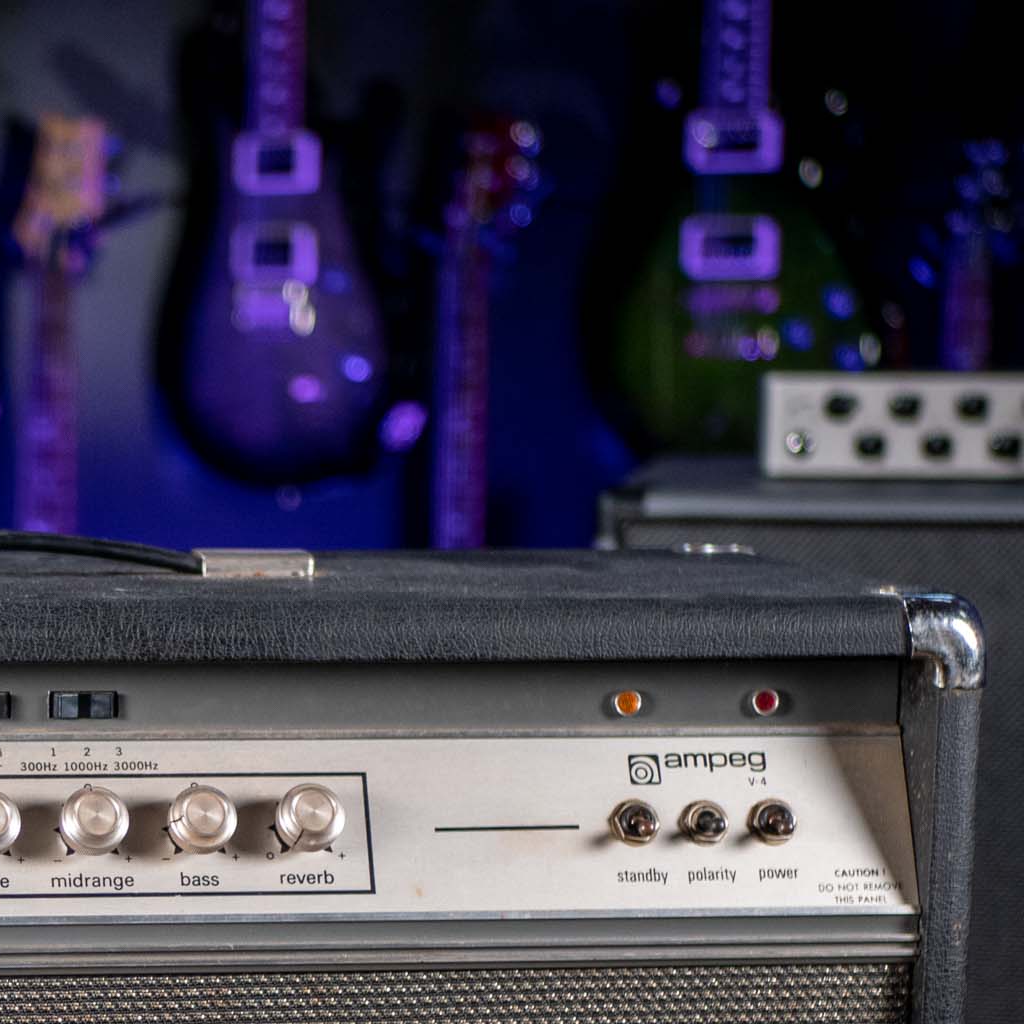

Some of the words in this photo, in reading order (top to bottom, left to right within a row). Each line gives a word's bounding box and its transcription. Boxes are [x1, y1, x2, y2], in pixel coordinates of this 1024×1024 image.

[50, 747, 57, 757] 1
[83, 747, 92, 757] 2
[115, 747, 124, 756] 3
[20, 762, 58, 772] 300Hz
[64, 761, 109, 772] 1000Hz
[114, 760, 160, 771] 3000Hz
[664, 752, 767, 773] ampeg
[179, 872, 220, 887] bass
[279, 869, 335, 885] reverb
[617, 867, 669, 885] standby
[687, 866, 737, 884] polarity
[758, 867, 799, 882] power
[834, 868, 879, 878] CAUTION
[50, 873, 135, 891] midrange
